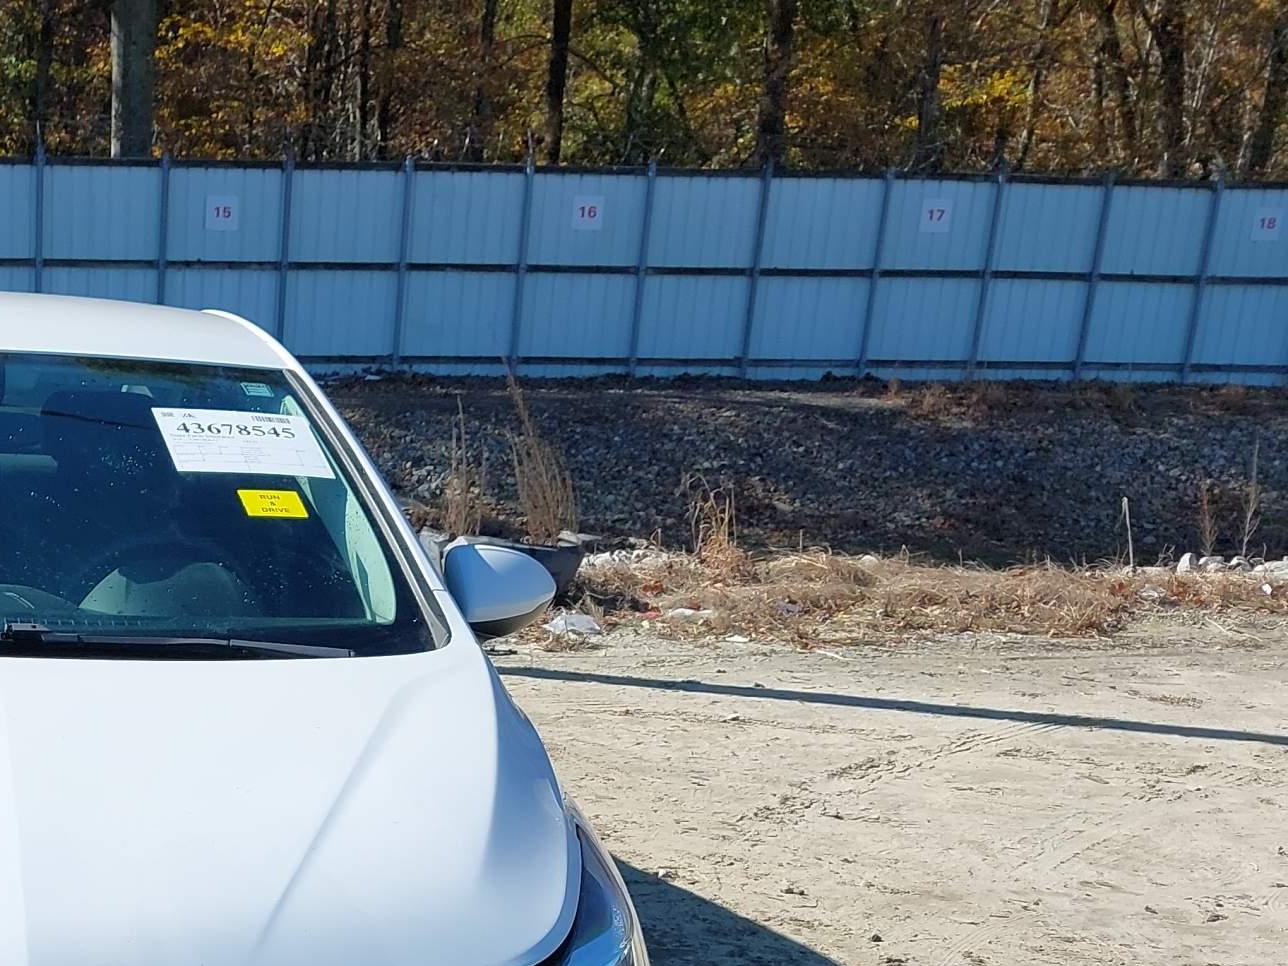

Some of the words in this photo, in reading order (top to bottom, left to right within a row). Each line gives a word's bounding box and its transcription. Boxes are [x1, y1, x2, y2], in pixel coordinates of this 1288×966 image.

[214, 207, 231, 219] 15
[579, 206, 598, 219] 16
[927, 208, 946, 222] 17
[1260, 217, 1277, 230] 18
[176, 422, 295, 439] 43678545
